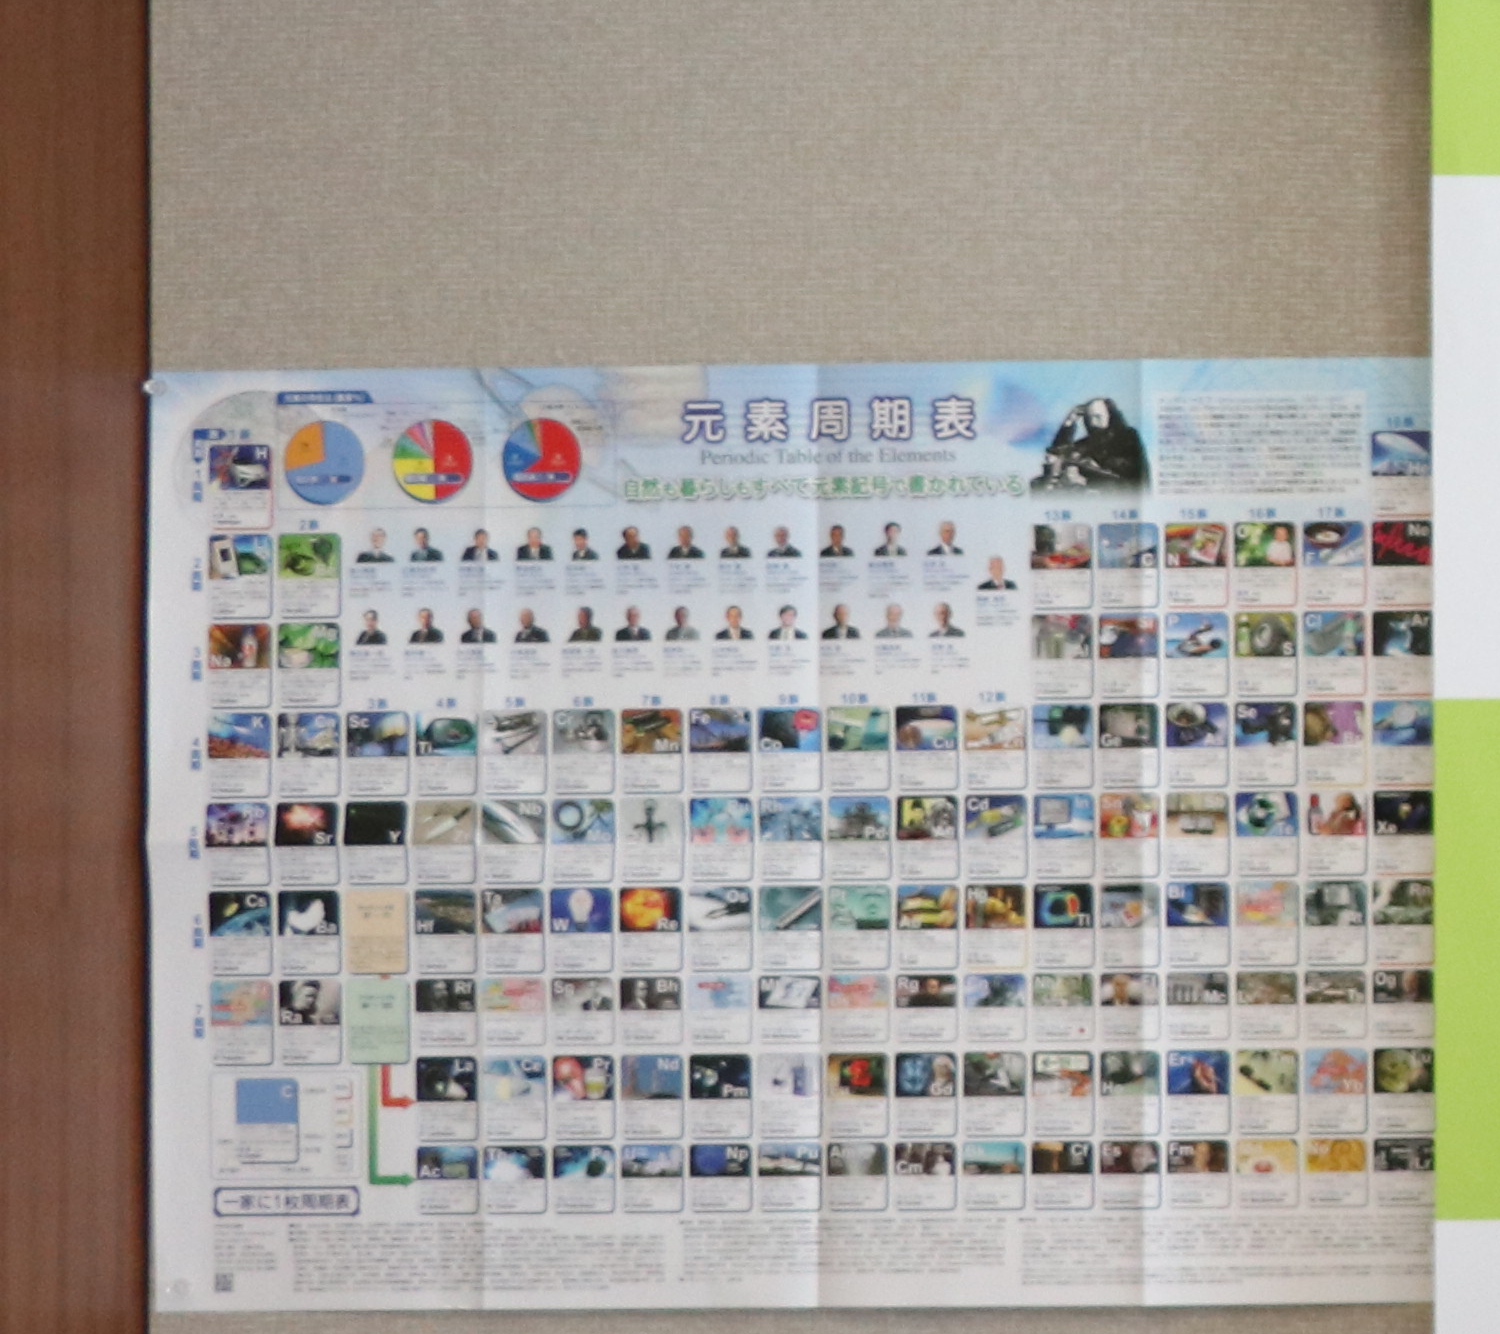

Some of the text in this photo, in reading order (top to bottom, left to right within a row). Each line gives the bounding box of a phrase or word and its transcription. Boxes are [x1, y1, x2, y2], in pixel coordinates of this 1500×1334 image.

[681, 395, 977, 444] 元素周期表
[701, 448, 956, 465] Periodic Table of the Elements
